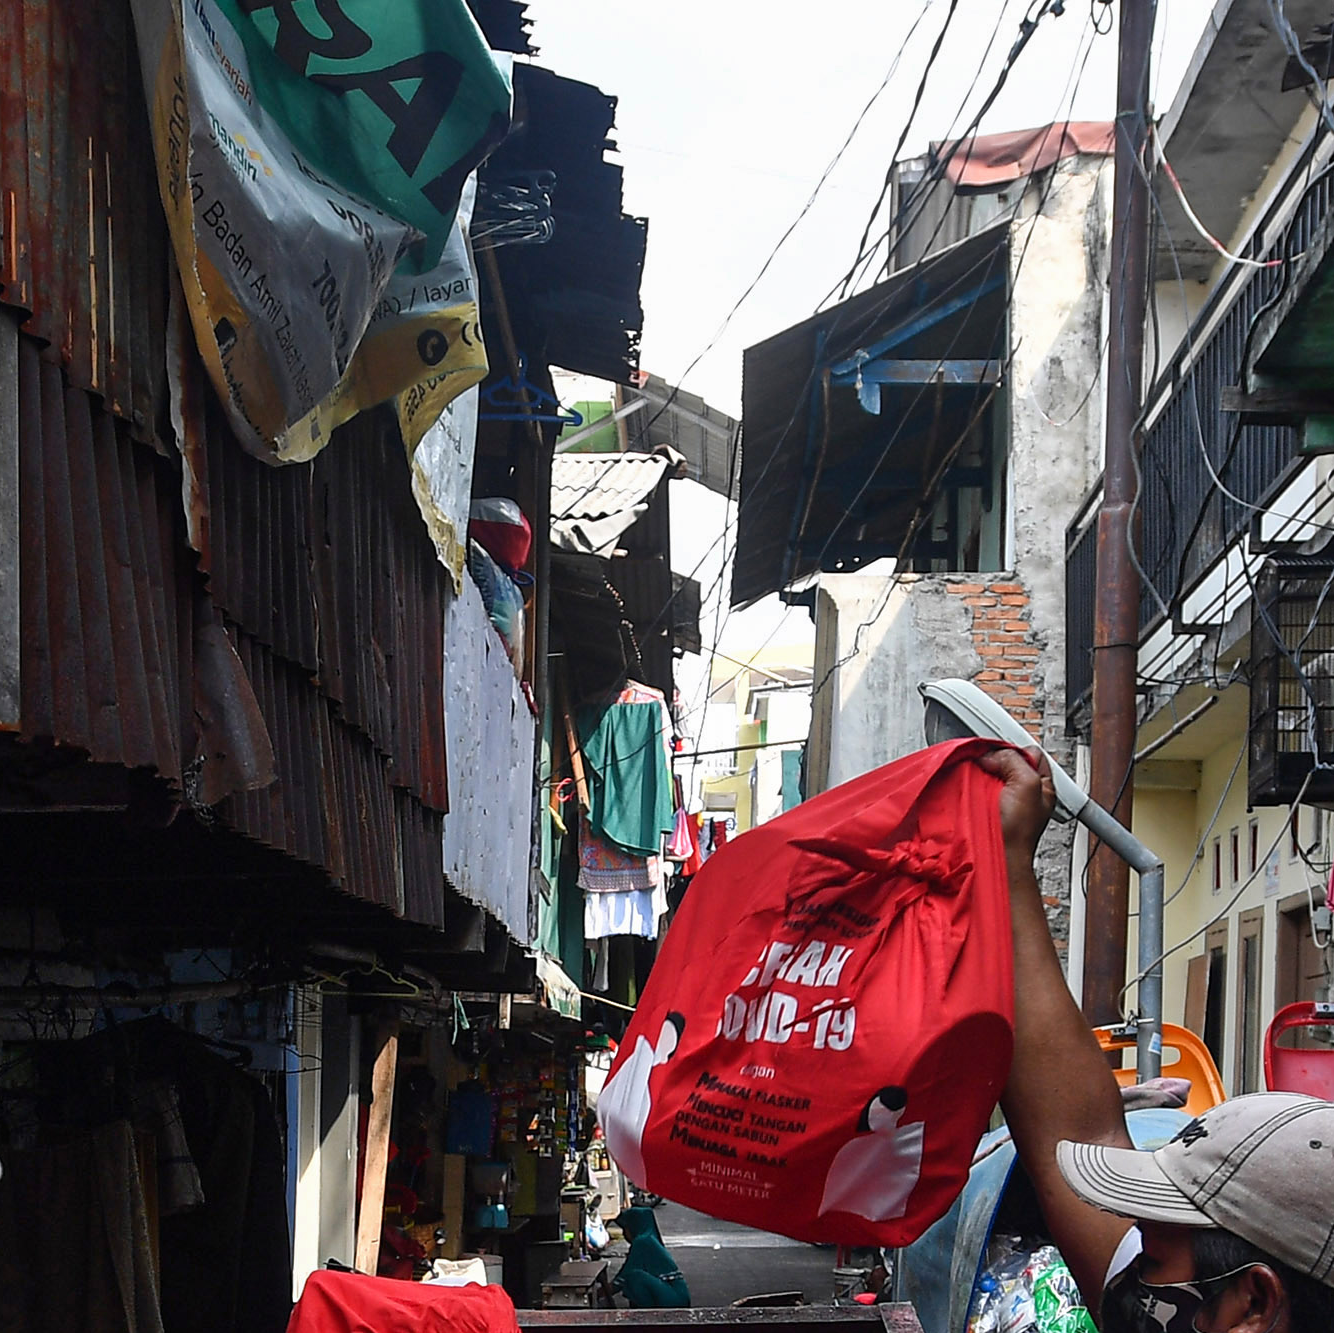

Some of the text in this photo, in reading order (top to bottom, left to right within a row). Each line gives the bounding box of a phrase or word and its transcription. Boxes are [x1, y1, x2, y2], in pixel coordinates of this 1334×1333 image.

[202, 200, 253, 279] Badan
[250, 271, 284, 323] Amil
[275, 315, 305, 375] Zakat
[755, 1090, 811, 1111] MASKER
[675, 1110, 779, 1147] DENGAN SABUN
[750, 1113, 807, 1134] TANGAN
[700, 1161, 757, 1181] MINIMAL
[728, 1184, 770, 1199] METER
